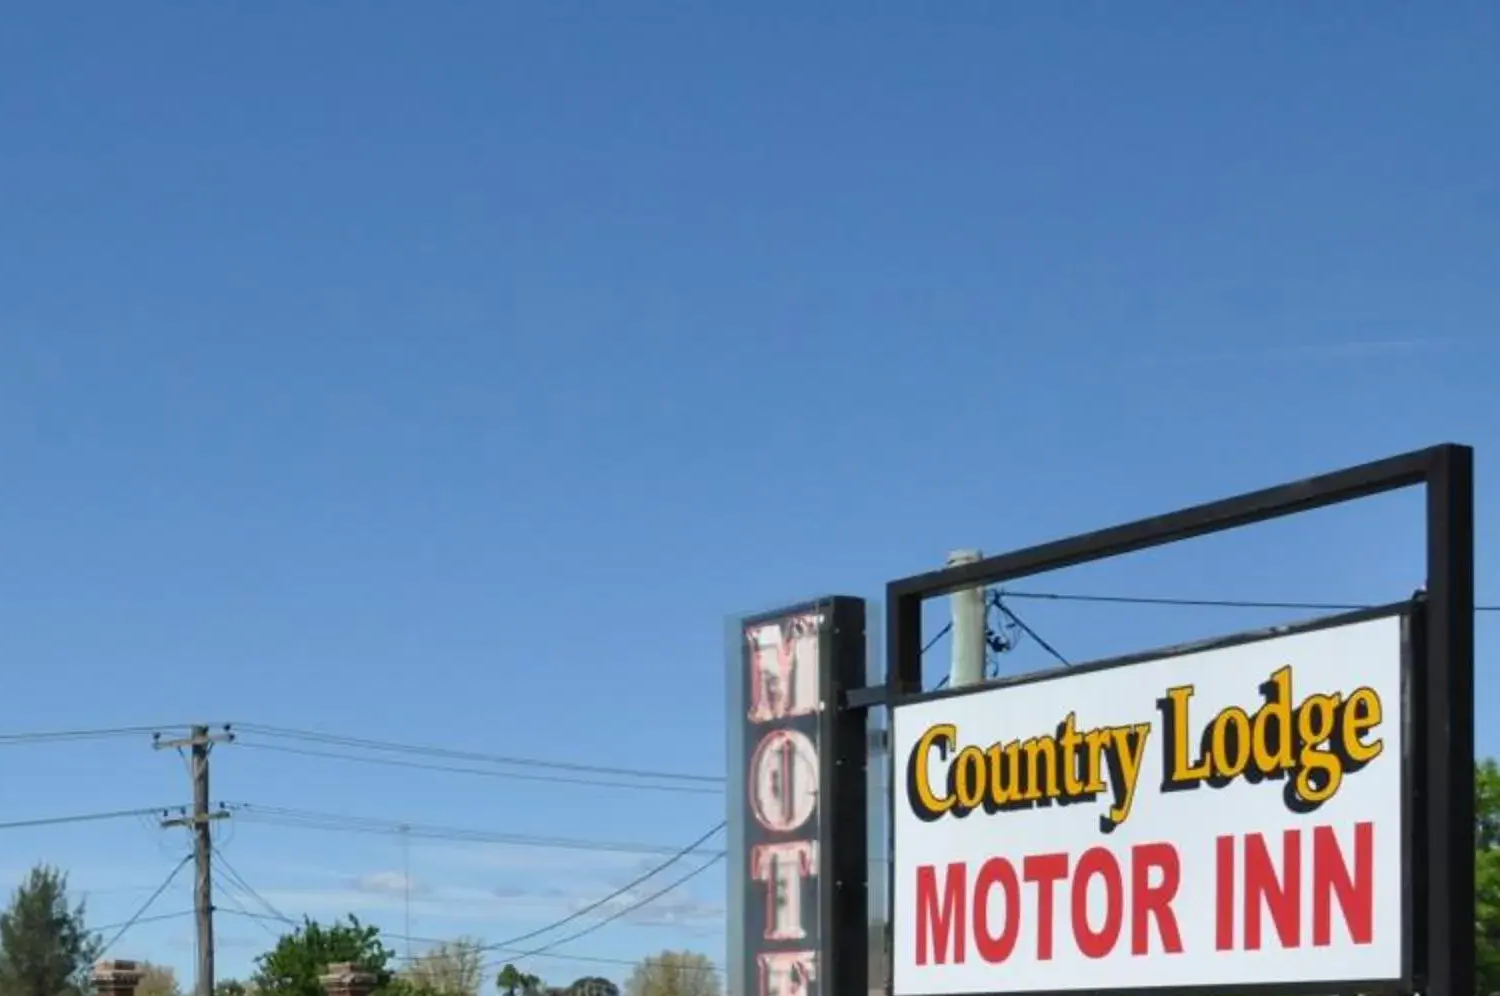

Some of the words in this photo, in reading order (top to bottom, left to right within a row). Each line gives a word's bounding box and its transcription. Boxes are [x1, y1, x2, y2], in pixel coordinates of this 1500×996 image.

[906, 711, 1152, 834] Country
[1156, 664, 1383, 814] Lodge
[915, 843, 1184, 966] MOTOR
[1215, 821, 1374, 951] INN
